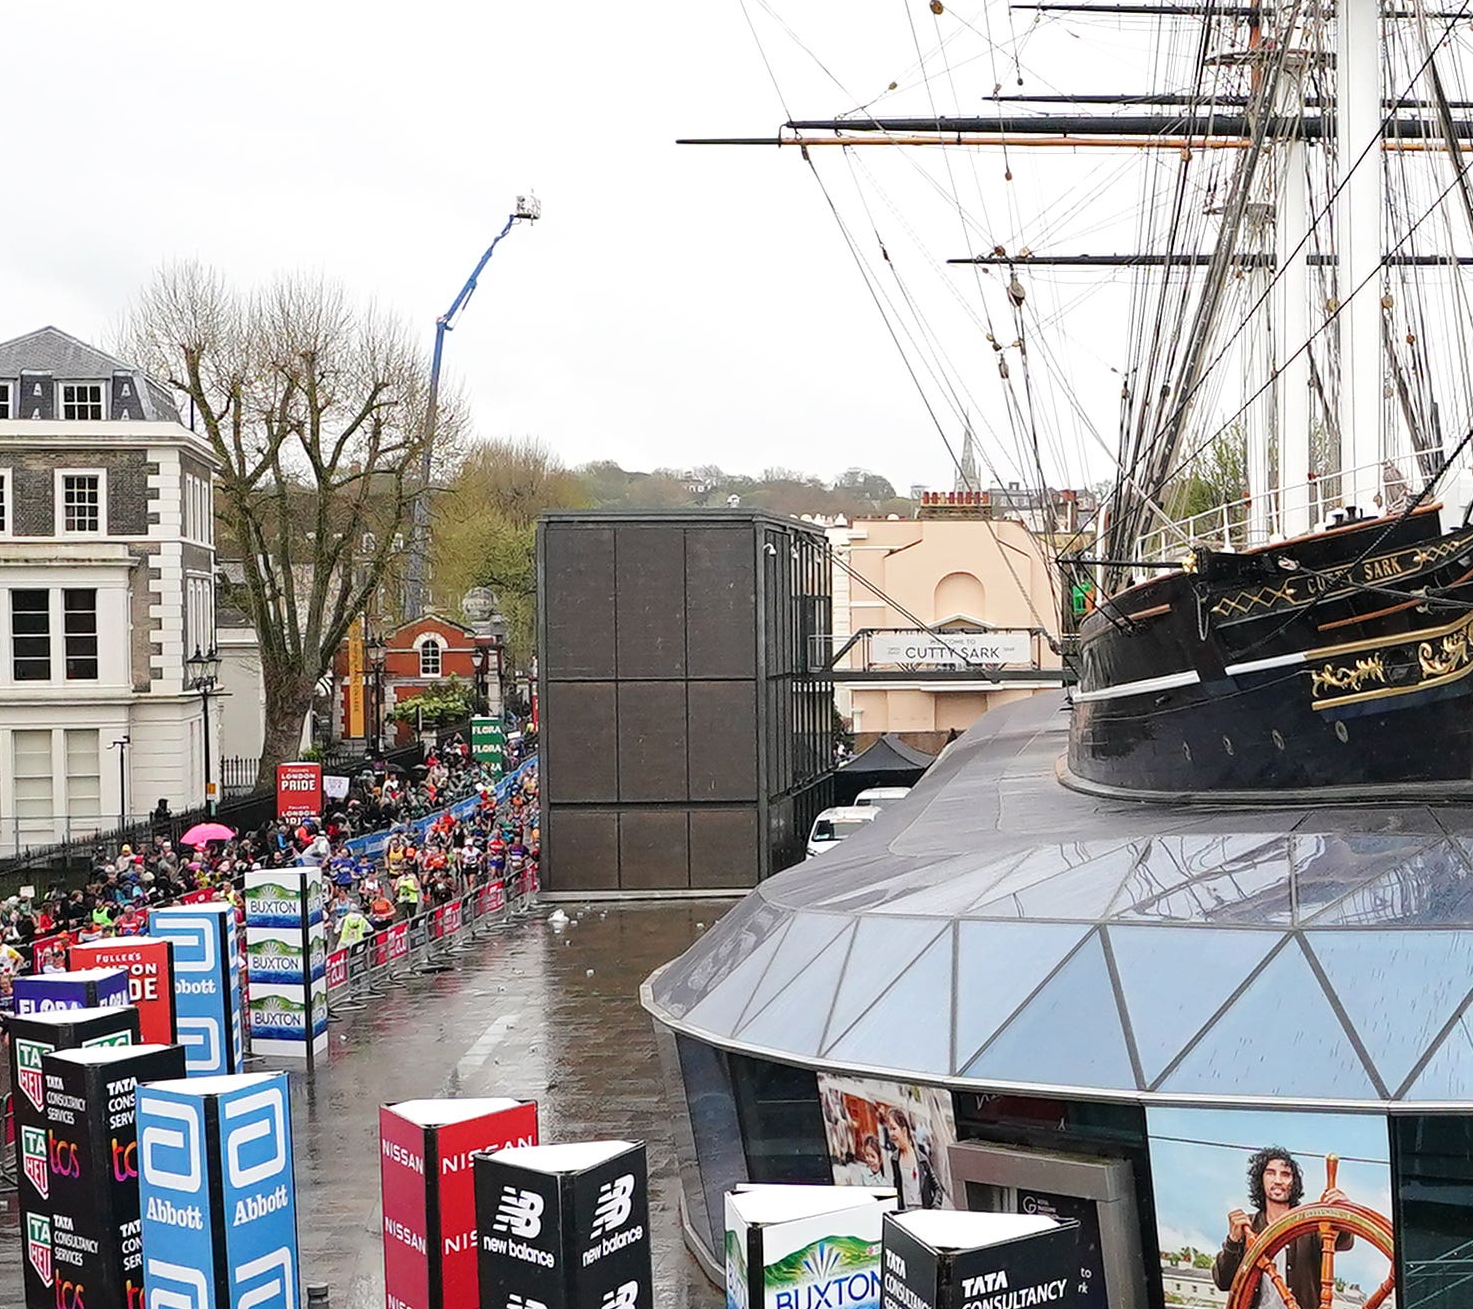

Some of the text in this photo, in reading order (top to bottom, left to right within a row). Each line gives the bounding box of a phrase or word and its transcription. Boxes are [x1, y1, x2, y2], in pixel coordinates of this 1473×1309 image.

[1364, 555, 1403, 580] SARK
[905, 646, 956, 658] CUTTY
[961, 646, 999, 659] SARK
[282, 780, 315, 790] PRIDE
[250, 899, 298, 915] BUXTON
[252, 955, 300, 971] BUXTON
[254, 1011, 302, 1027] BUXTON
[47, 1107, 74, 1124] SERVICES
[48, 1129, 80, 1179] tcs
[383, 1139, 423, 1174] NISSAN
[147, 1197, 203, 1229] Abbott
[233, 1185, 288, 1226] Abbott
[53, 1215, 73, 1231] TATA
[385, 1217, 426, 1254] NISSAN
[54, 1231, 98, 1253] CONSULTANCY
[484, 1237, 554, 1267] new balance
[582, 1224, 643, 1268] new balance
[55, 1247, 83, 1266] SERVICES
[886, 1249, 906, 1279] TATA
[962, 1271, 1007, 1297] TATA
